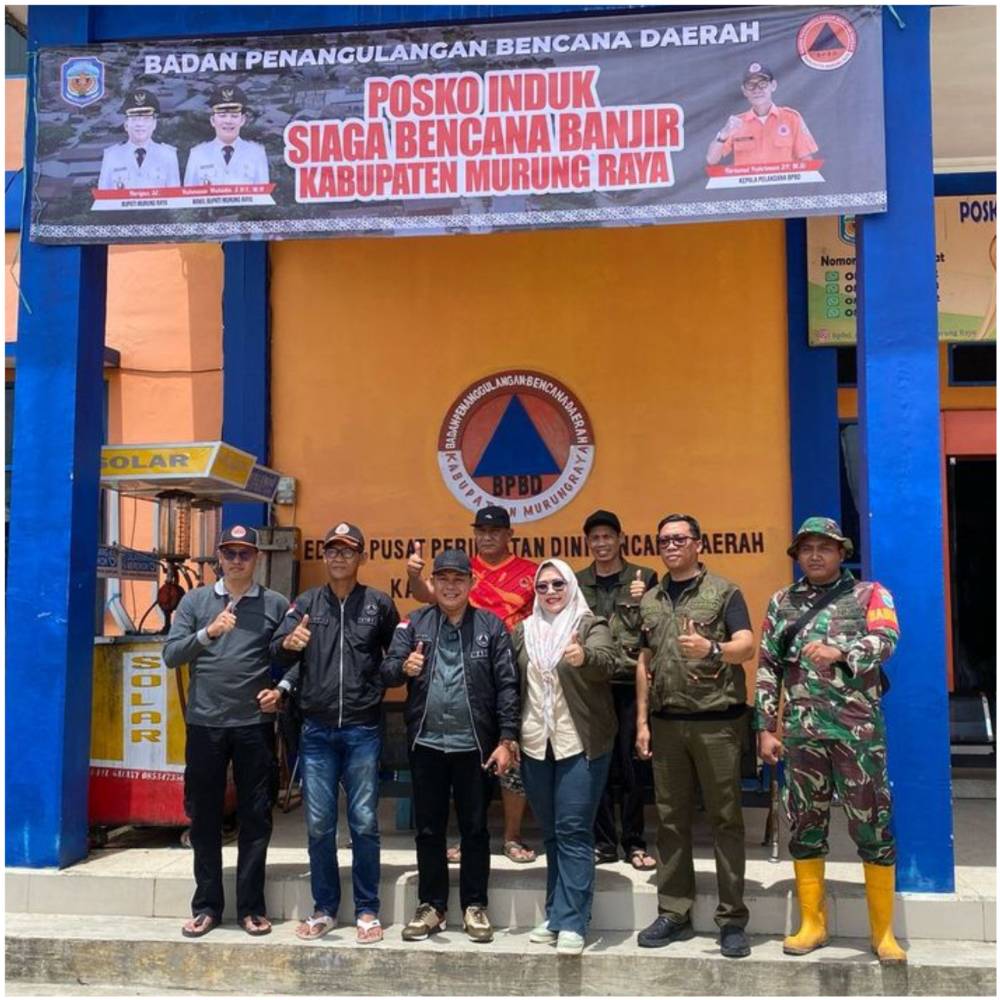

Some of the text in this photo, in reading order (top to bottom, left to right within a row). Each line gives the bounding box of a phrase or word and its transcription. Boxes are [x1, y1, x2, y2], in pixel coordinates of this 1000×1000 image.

[144, 21, 760, 75] BADAN PENANGULANGAN BENCANA DAERAH
[368, 70, 596, 118] POSKO INDUK
[287, 108, 680, 165] SIAGA BENCANA BANJIR
[299, 151, 669, 199] KABUPATEN MURUNG RAYA
[820, 254, 856, 267] Nomor
[492, 474, 543, 497] BPBD
[701, 531, 764, 555] AERAH
[131, 656, 161, 743] SOLAR
